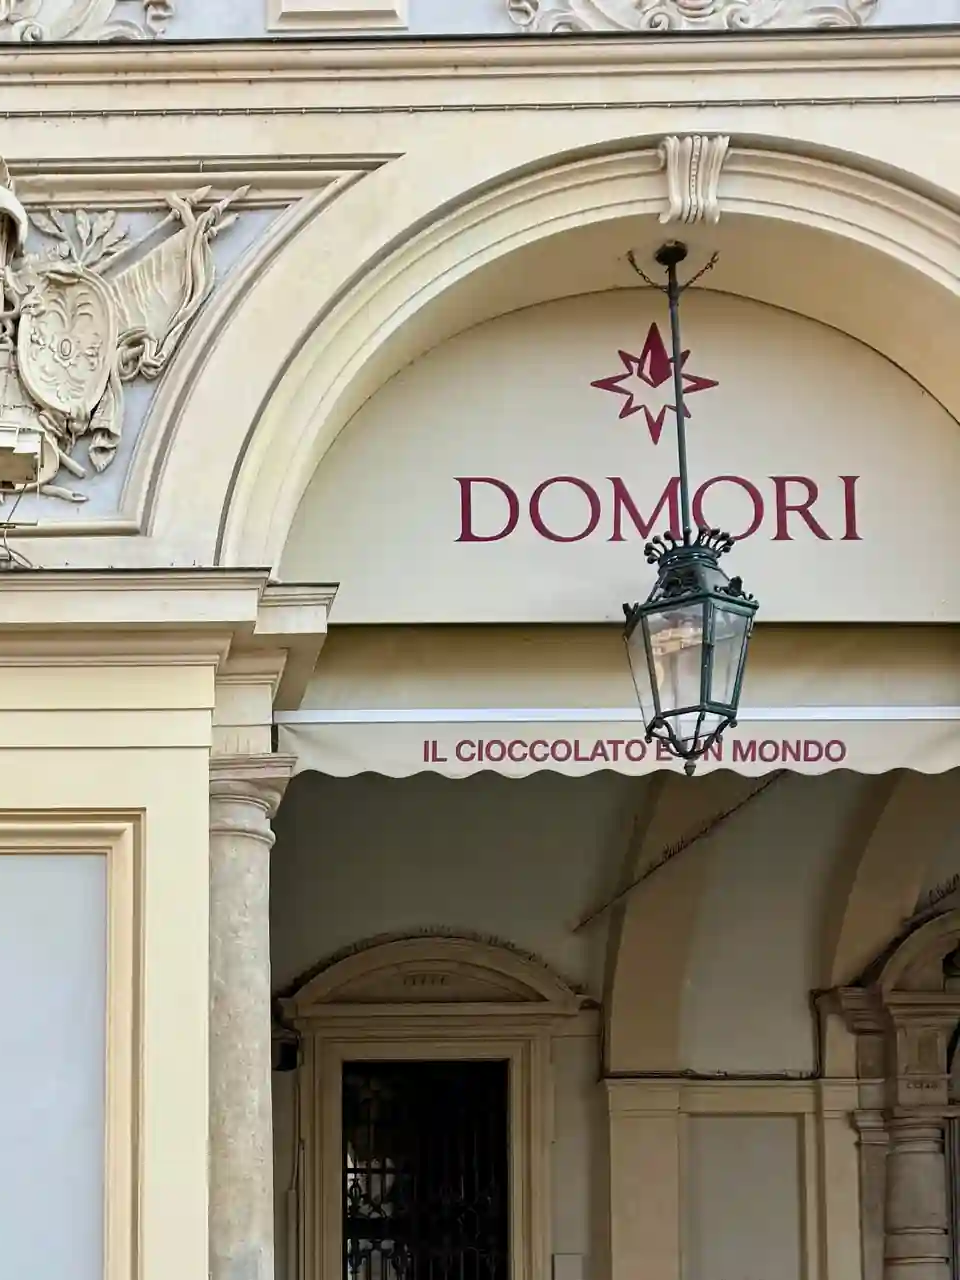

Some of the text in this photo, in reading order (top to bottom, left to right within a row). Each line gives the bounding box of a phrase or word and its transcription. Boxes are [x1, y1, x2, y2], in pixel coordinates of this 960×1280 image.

[452, 474, 863, 543] DOMORI
[423, 740, 448, 762] IL
[455, 739, 647, 762] CIOCCOLATO
[732, 739, 847, 762] MONDO
